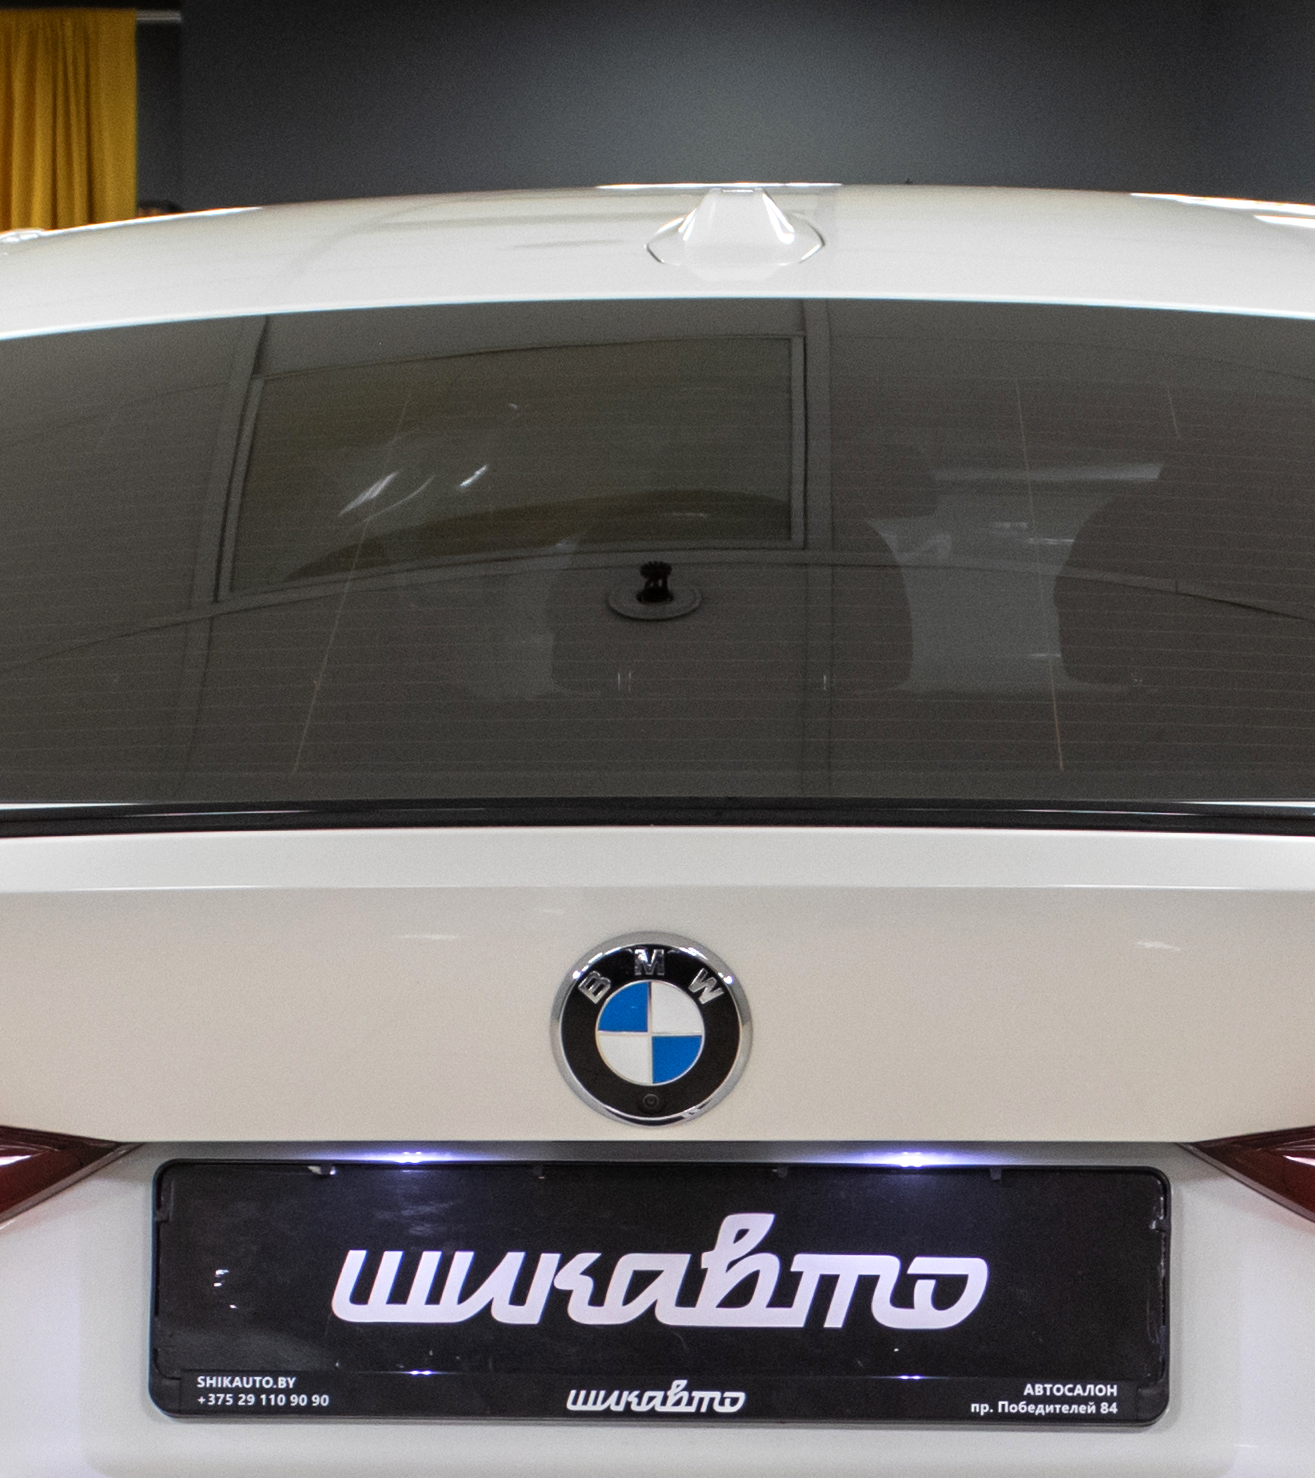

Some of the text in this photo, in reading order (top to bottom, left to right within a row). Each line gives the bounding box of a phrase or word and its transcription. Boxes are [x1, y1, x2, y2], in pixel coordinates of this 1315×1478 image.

[577, 948, 725, 1005] BMW
[331, 1212, 988, 1329] шикавто
[196, 1375, 297, 1389] SHIKAUTO.BY
[1023, 1383, 1118, 1397] АВТОСАЛОН
[197, 1393, 330, 1407] +375 29 110 90 90
[970, 1400, 1118, 1416] пр. Победителей 84
